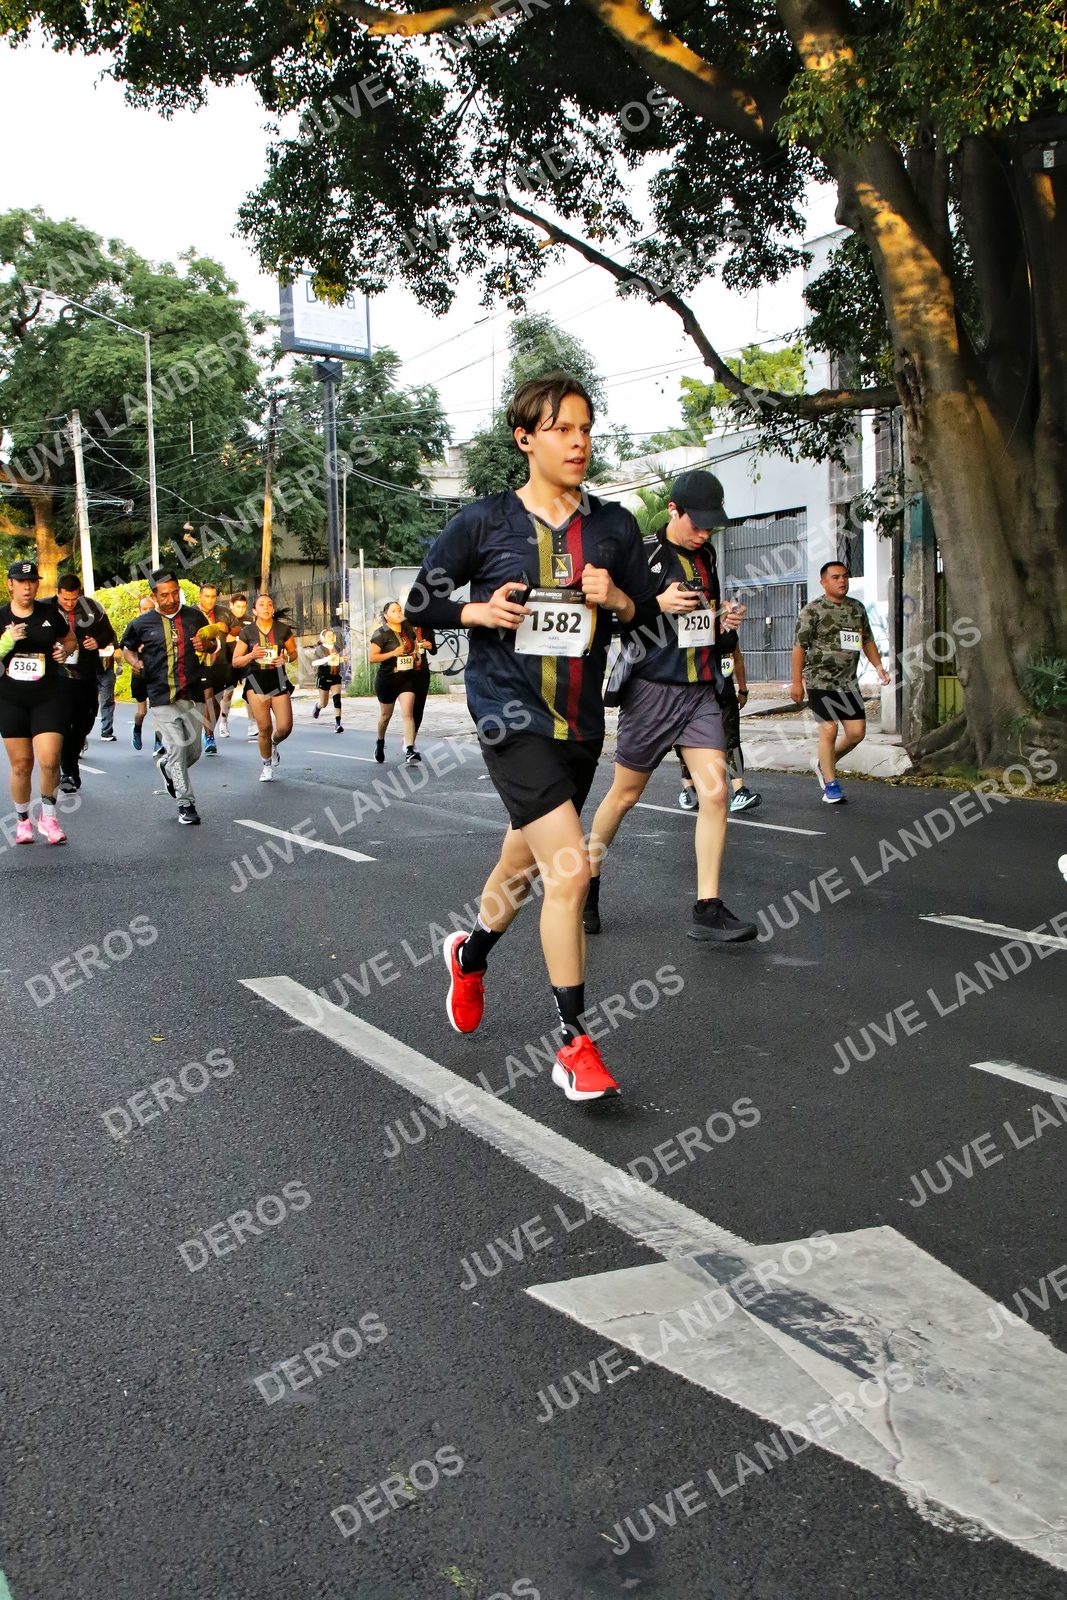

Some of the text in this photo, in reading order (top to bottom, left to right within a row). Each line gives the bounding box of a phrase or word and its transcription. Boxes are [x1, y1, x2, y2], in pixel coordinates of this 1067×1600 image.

[531, 611, 581, 633] 1582
[684, 615, 710, 631] 2520
[843, 634, 859, 642] 3810
[14, 661, 37, 671] 5362
